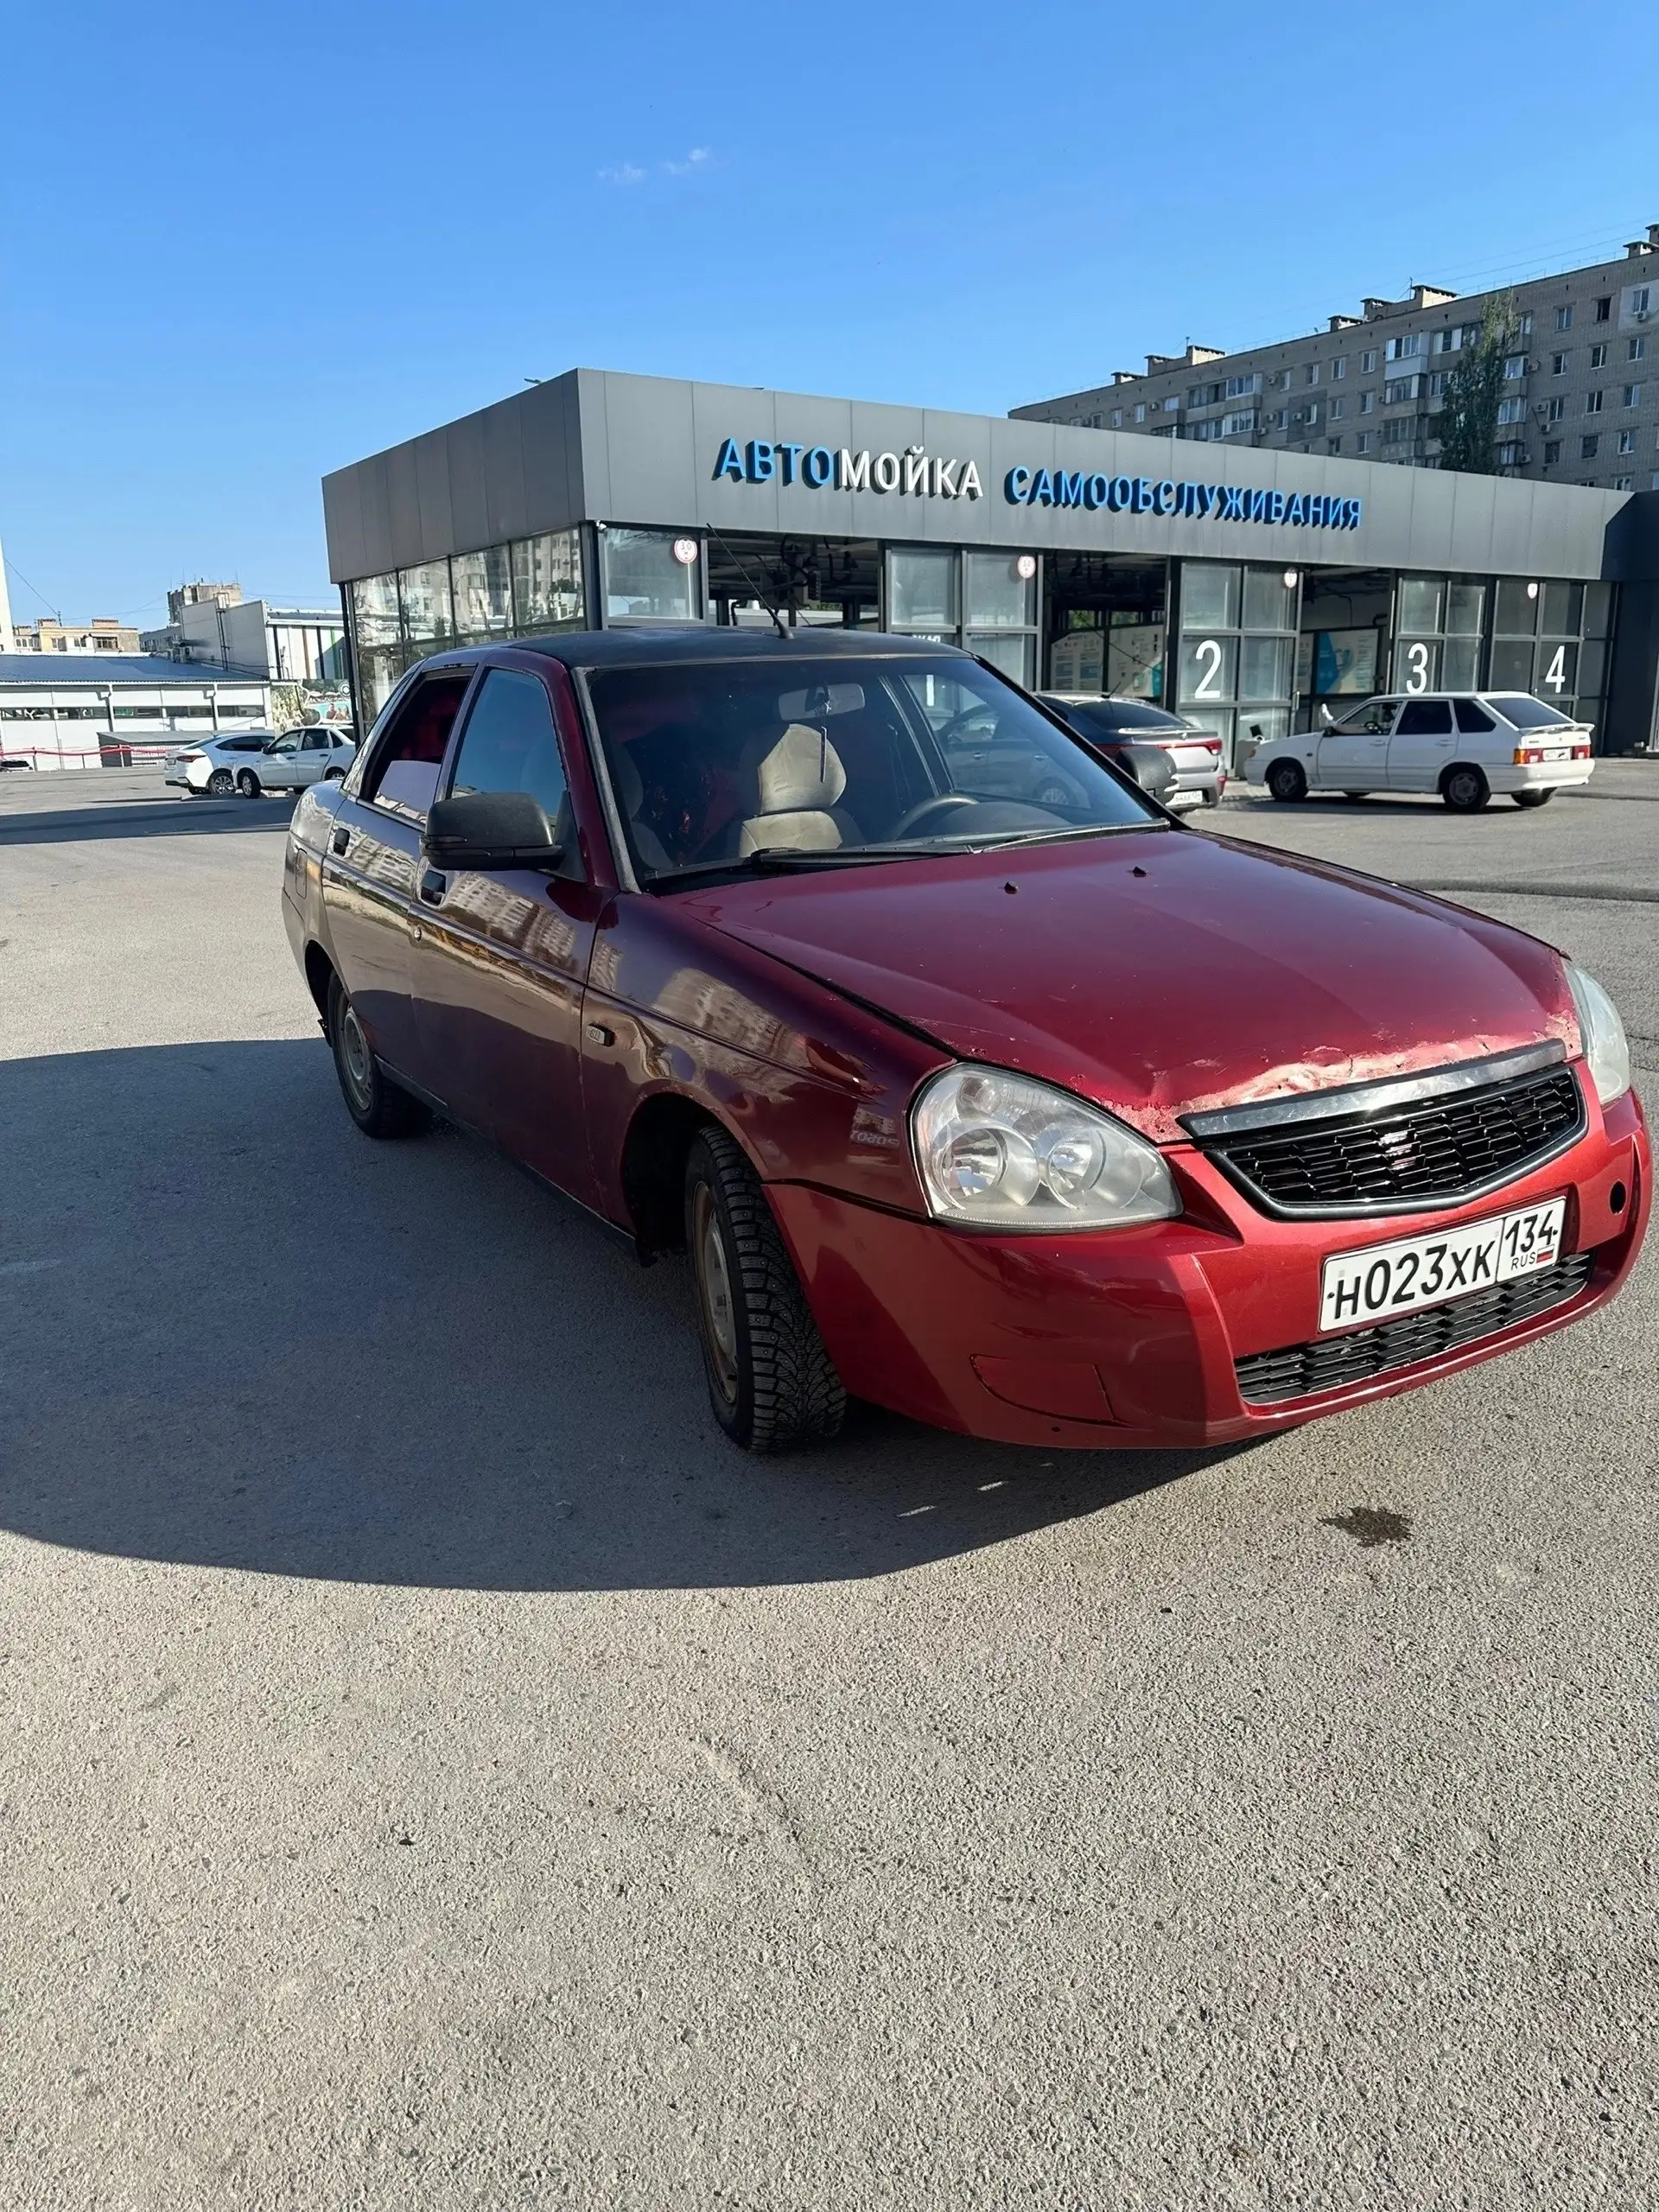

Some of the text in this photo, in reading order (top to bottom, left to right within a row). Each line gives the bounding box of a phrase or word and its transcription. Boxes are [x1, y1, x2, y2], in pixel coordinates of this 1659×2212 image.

[717, 438, 1363, 529] АВТОМОЙКА САМООБСЛУЖИВАНИЯ
[1195, 639, 1221, 698] 2
[1406, 643, 1428, 695] 3
[1545, 645, 1566, 693] 4
[1333, 1210, 1554, 1320] Н023ХК 134
[1510, 1254, 1536, 1271] RUS
